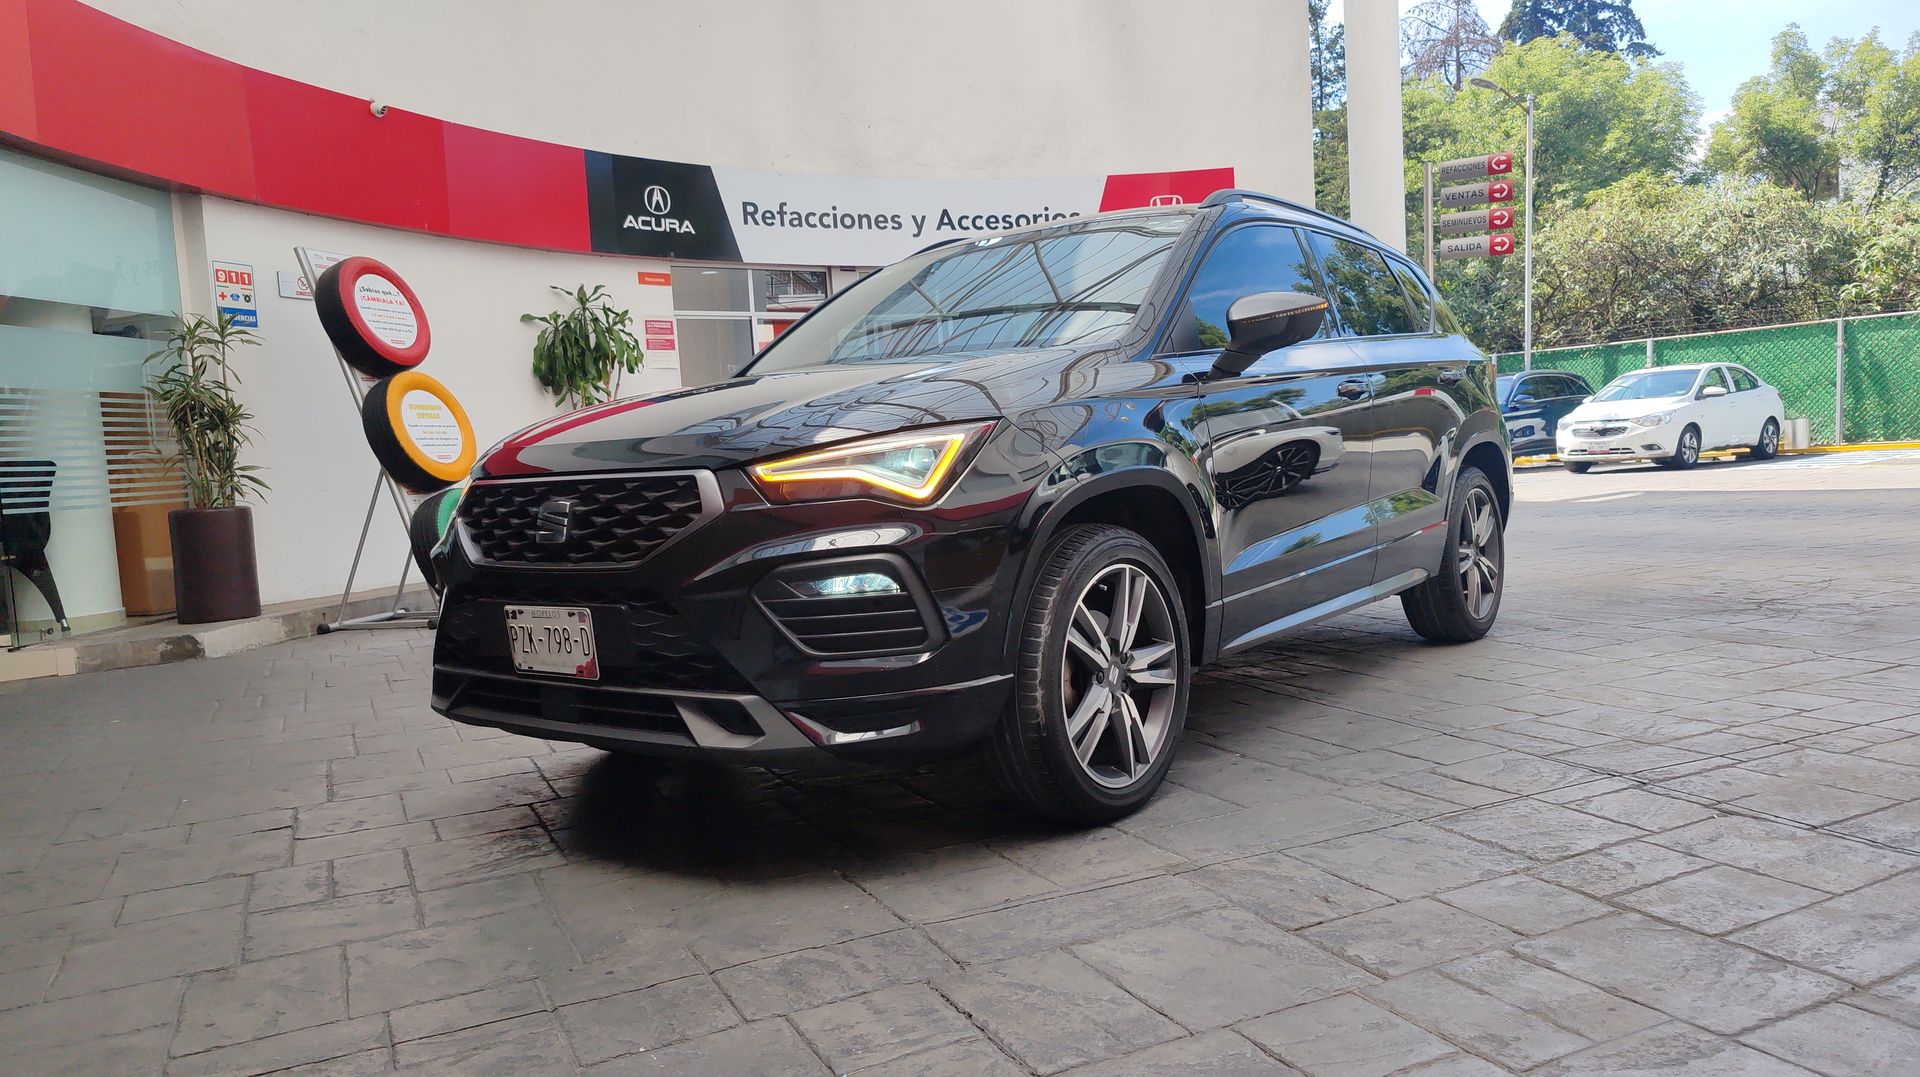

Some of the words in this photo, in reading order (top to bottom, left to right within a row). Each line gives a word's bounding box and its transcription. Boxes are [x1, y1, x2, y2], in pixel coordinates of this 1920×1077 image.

[1441, 161, 1486, 174] REFACCIONES
[1445, 189, 1484, 201] VENTAS
[622, 214, 696, 235] ACURA
[741, 201, 903, 231] Refacciones
[911, 214, 926, 238] y
[936, 206, 1081, 231] Accesori
[1442, 215, 1487, 228] SEMINUEVOS
[1447, 242, 1482, 253] SALIDA
[217, 270, 249, 285] 911
[508, 625, 591, 656] PZK-798-D
